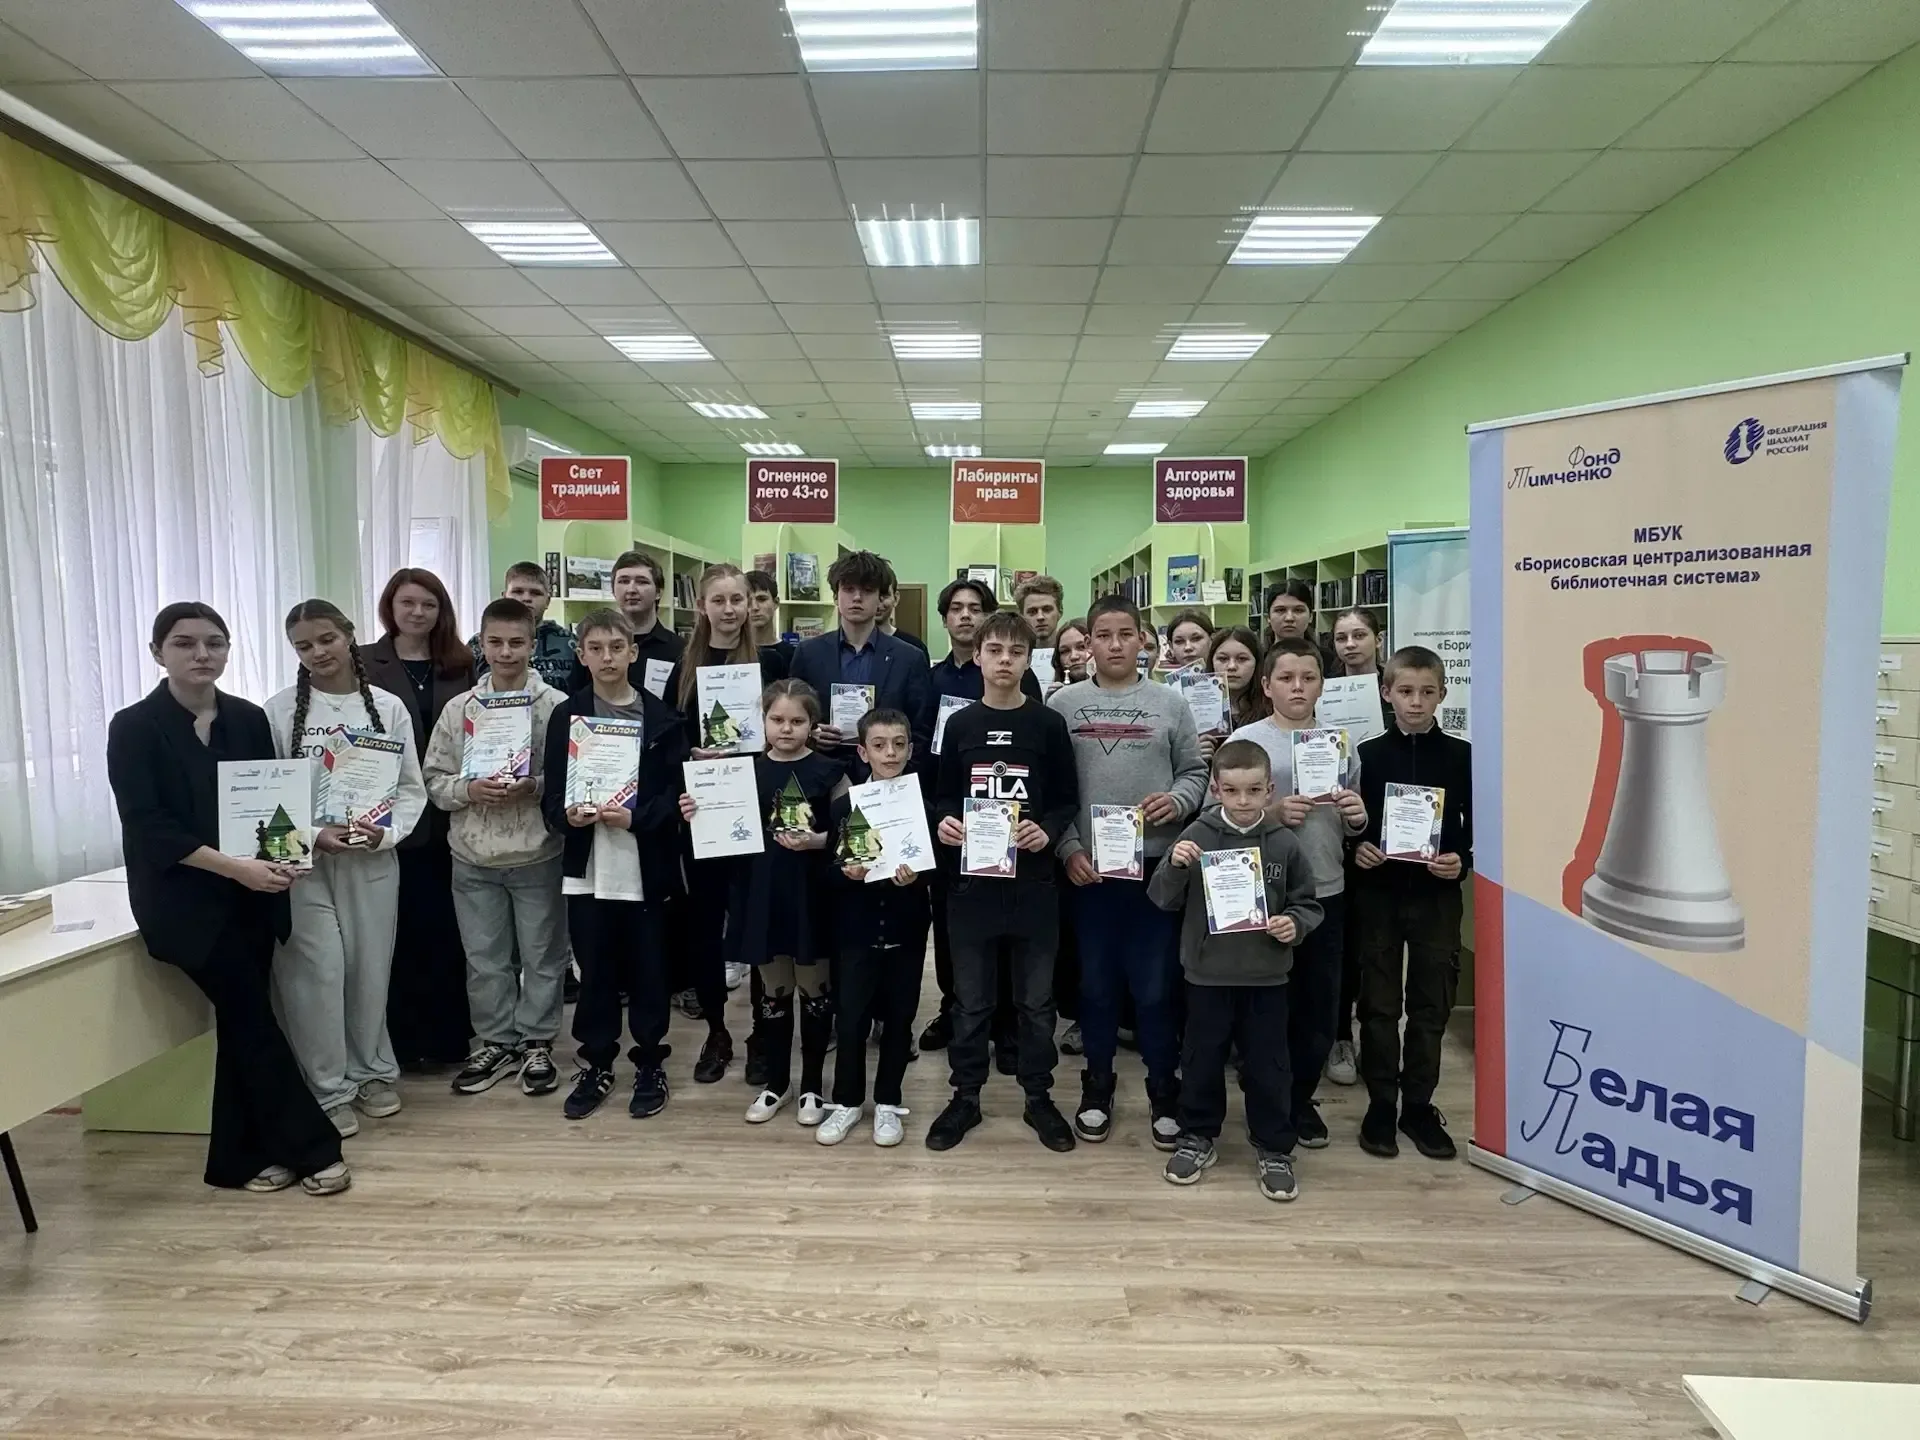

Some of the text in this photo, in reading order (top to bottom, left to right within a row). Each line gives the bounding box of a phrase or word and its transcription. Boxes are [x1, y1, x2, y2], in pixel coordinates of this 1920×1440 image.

[1766, 421, 1828, 435] ФЕДЕРАЦИЯ
[1766, 433, 1811, 446] ШАХМАТ
[1568, 445, 1621, 469] Фонд
[1766, 445, 1809, 456] РОССИИ
[569, 464, 604, 479] Свет
[757, 467, 828, 483] Огненное
[956, 467, 1039, 486] Лабиринты
[1164, 467, 1236, 485] Алгоритм
[1507, 466, 1612, 489] Тимченко
[551, 480, 621, 498] традиций
[755, 484, 829, 499] лето 43-го
[976, 487, 1019, 502] права
[1166, 486, 1236, 501] здоровья
[1633, 525, 1684, 544] МБУК
[1513, 543, 1812, 574] «Борисовская централизованная
[1550, 570, 1762, 591] библиотечная система»
[486, 697, 529, 708] Диплом
[593, 724, 639, 735] Диплом
[353, 736, 402, 751] Диплом
[970, 776, 1028, 799] FILA
[1543, 1018, 1756, 1153] Белая
[1520, 1087, 1754, 1226] Ладья
